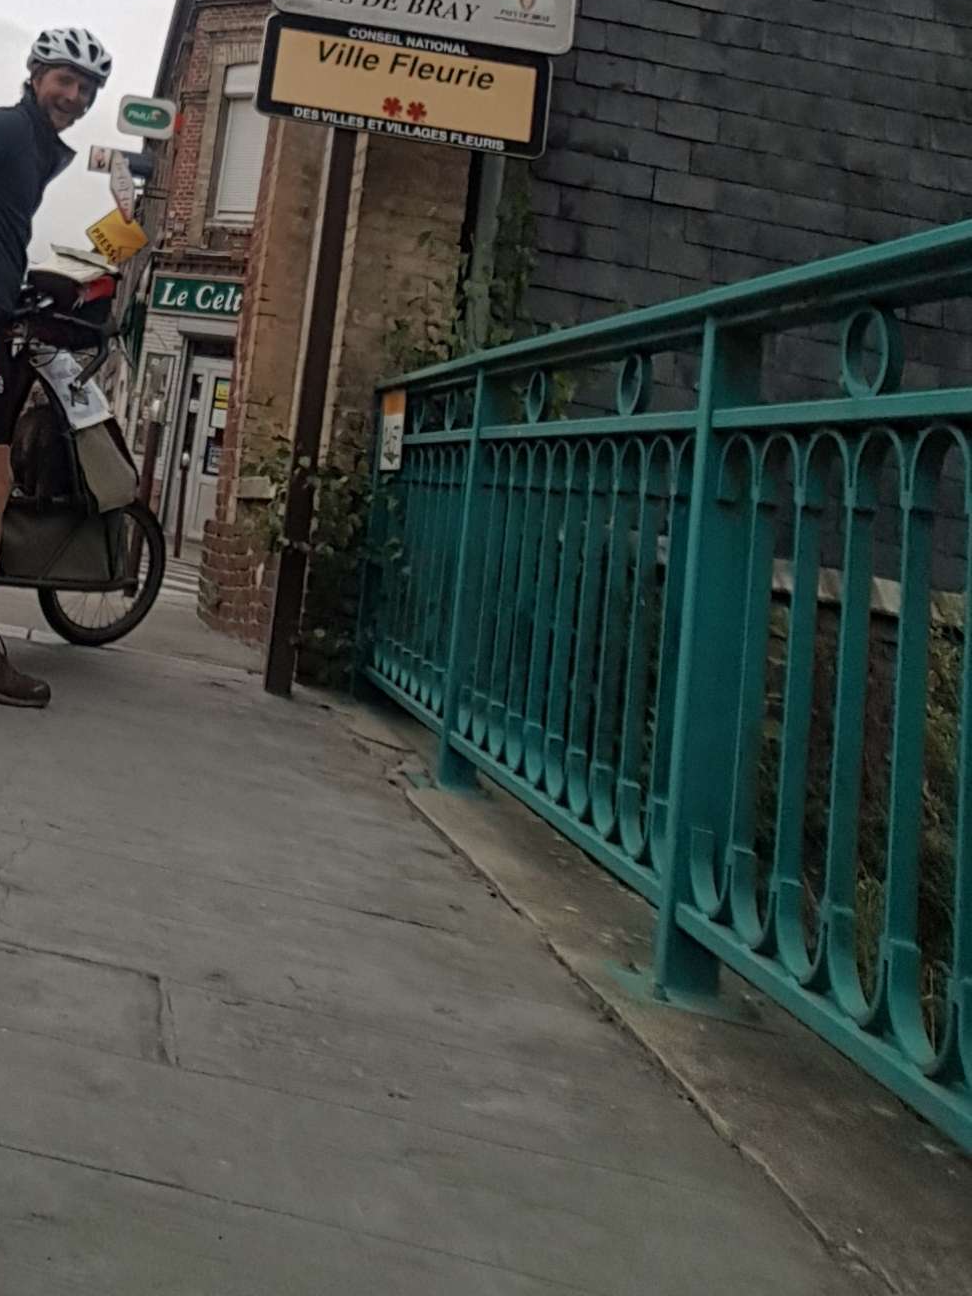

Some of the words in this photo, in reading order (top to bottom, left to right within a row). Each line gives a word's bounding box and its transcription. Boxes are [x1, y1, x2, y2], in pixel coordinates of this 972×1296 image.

[348, 27, 403, 45] CONSEIL
[406, 37, 469, 56] NATIONAL
[318, 40, 380, 71] Ville
[389, 53, 496, 90] Fleurie
[293, 107, 319, 121] DES
[321, 112, 365, 128] VILLES
[367, 119, 383, 131] ET
[386, 122, 448, 142] VILLAGES
[450, 132, 506, 152] FLEURIS
[159, 282, 189, 307] Le
